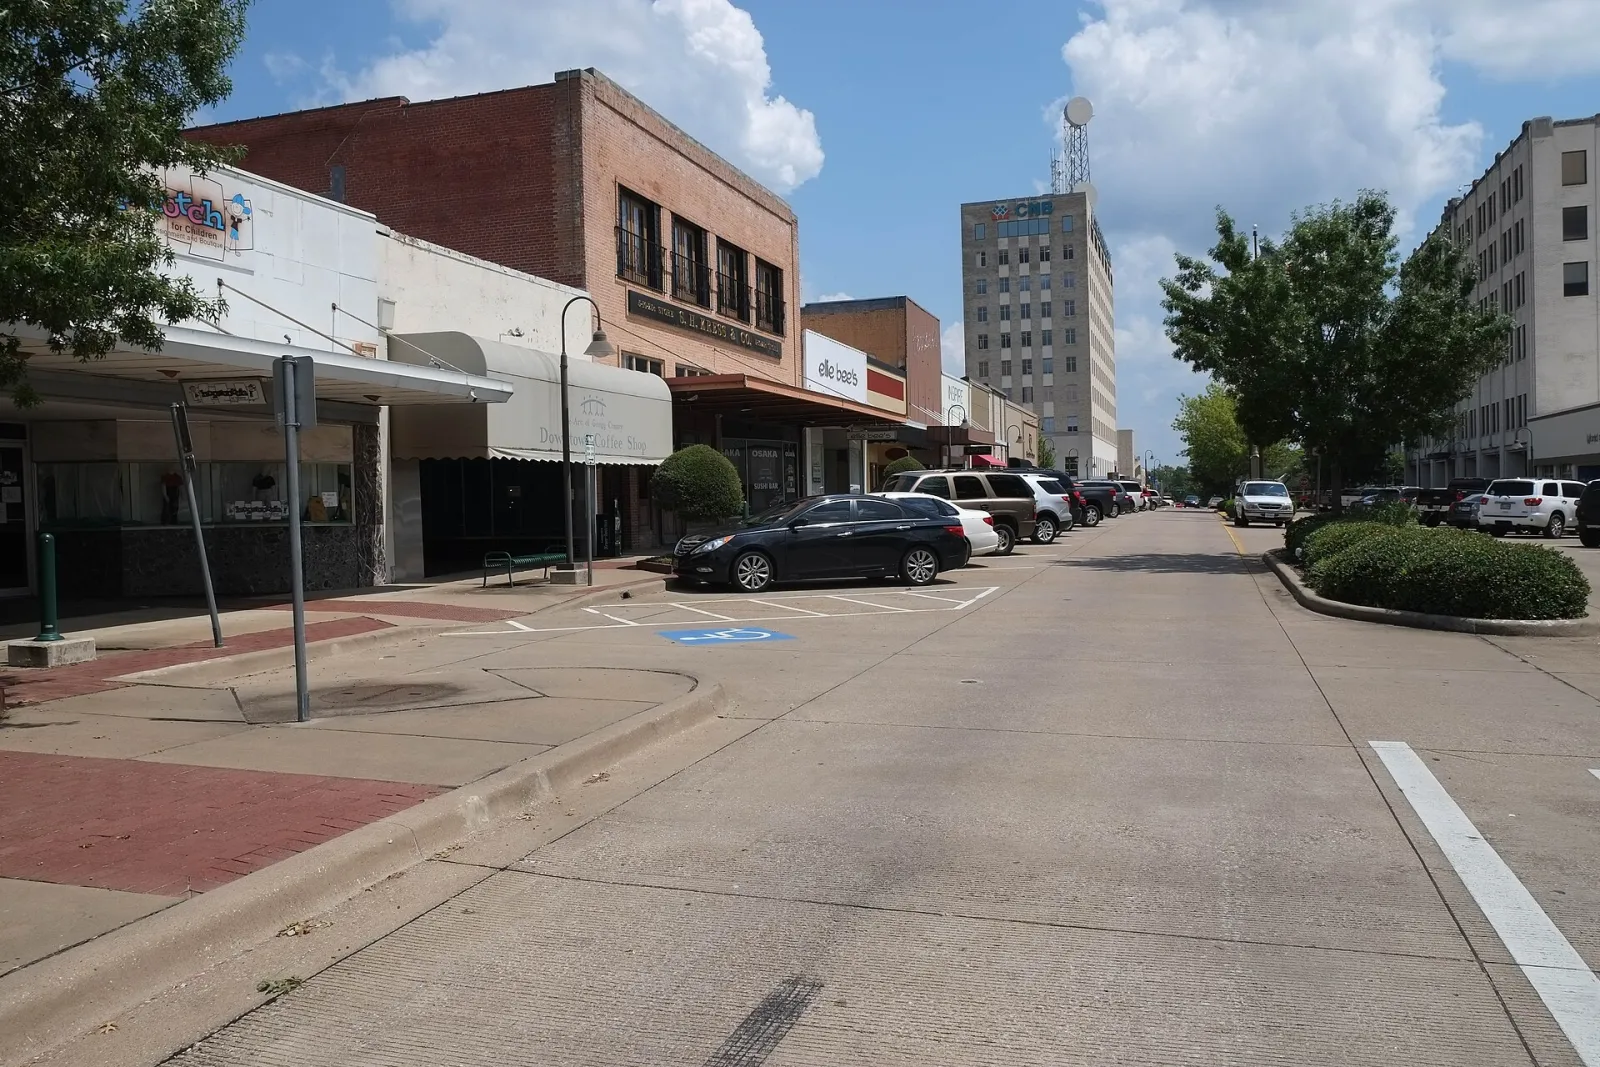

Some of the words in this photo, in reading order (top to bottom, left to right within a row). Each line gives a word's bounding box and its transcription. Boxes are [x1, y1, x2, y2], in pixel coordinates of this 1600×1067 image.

[1015, 201, 1053, 217] CNB
[171, 222, 182, 231] for
[185, 225, 218, 240] Children
[187, 235, 197, 243] and
[199, 237, 224, 249] Boutique
[700, 317, 727, 338] KRESS
[730, 328, 736, 340] &
[836, 362, 858, 387] bee's
[540, 427, 587, 448] Dowtow
[594, 433, 623, 450] Coffee
[627, 436, 647, 455] Shop
[724, 448, 740, 457] AKA
[752, 450, 778, 458] OSAKA
[754, 482, 768, 490] SUSHI
